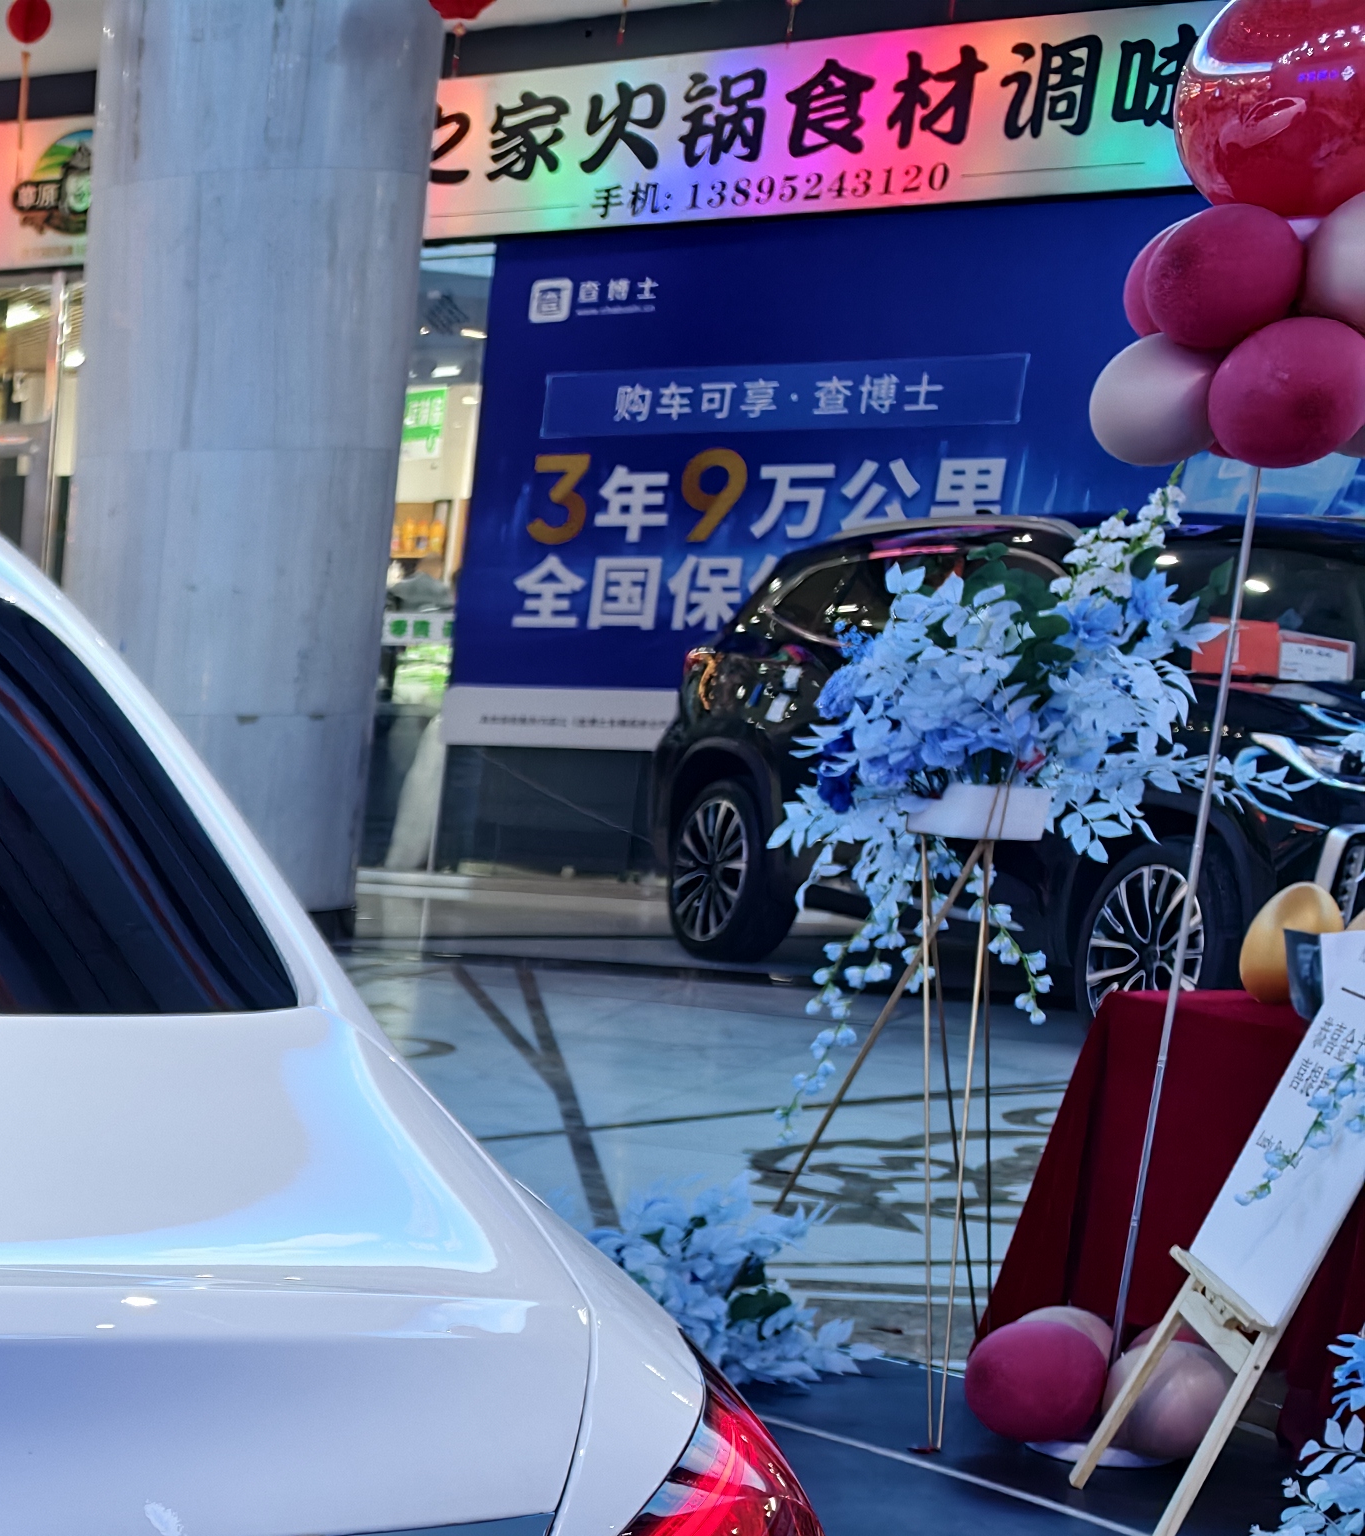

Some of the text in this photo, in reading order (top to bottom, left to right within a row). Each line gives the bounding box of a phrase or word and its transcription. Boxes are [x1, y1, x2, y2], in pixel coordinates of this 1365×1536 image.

[685, 161, 950, 212] 13895243120
[526, 446, 1007, 545] 3年9万公里
[511, 554, 777, 632] 全国保
